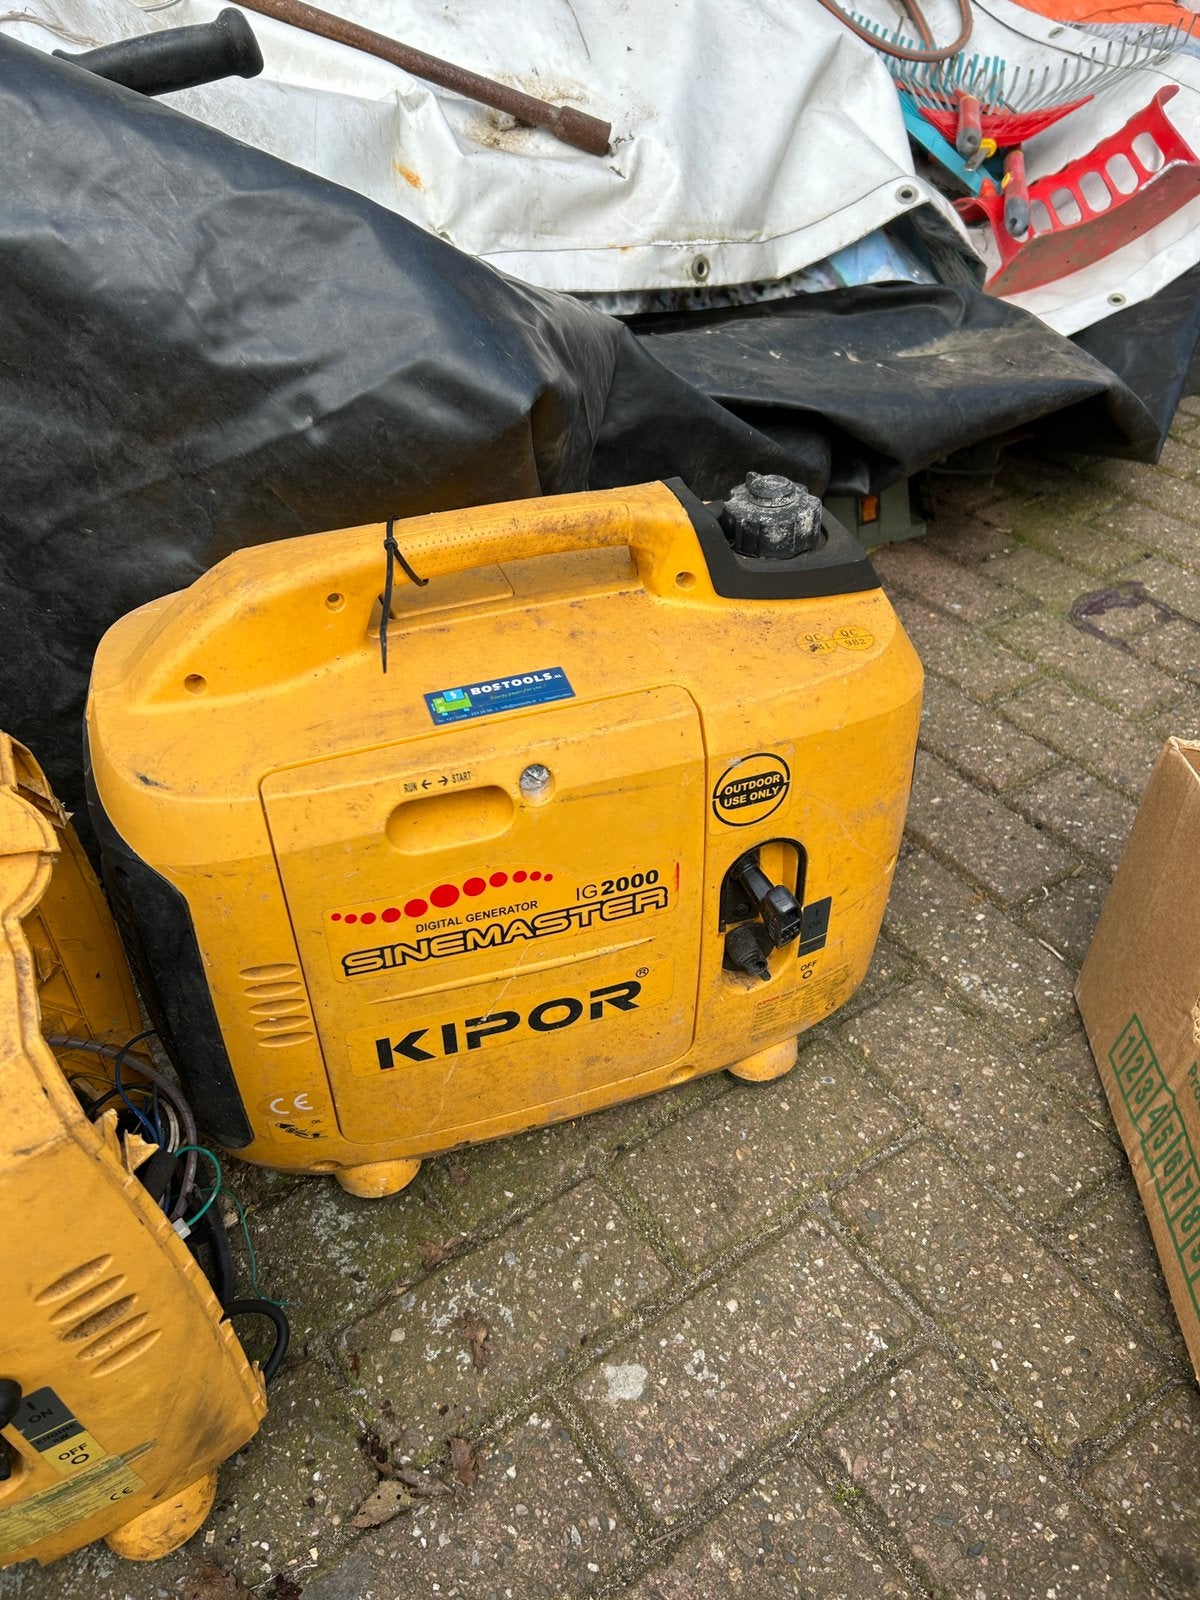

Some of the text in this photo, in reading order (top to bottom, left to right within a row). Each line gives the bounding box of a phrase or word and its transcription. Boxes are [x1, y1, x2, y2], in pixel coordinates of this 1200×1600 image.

[404, 771, 472, 793] RUN START
[724, 774, 781, 795] OUTDOOR
[724, 786, 780, 807] USE ONLY
[416, 900, 538, 933] DIGITAL GENERATOR
[341, 885, 668, 977] SINEMASTER
[800, 959, 817, 971] OFF
[1119, 1035, 1136, 1060] 1
[1126, 1055, 1144, 1083] 2
[1135, 1077, 1154, 1104] 3
[269, 1093, 314, 1115] CE
[1148, 1104, 1168, 1130] 4
[1153, 1122, 1174, 1150] 5
[1164, 1151, 1184, 1177] 6
[1170, 1174, 1194, 1200] 7
[29, 1408, 53, 1423] ON
[58, 1442, 88, 1461] OFF
